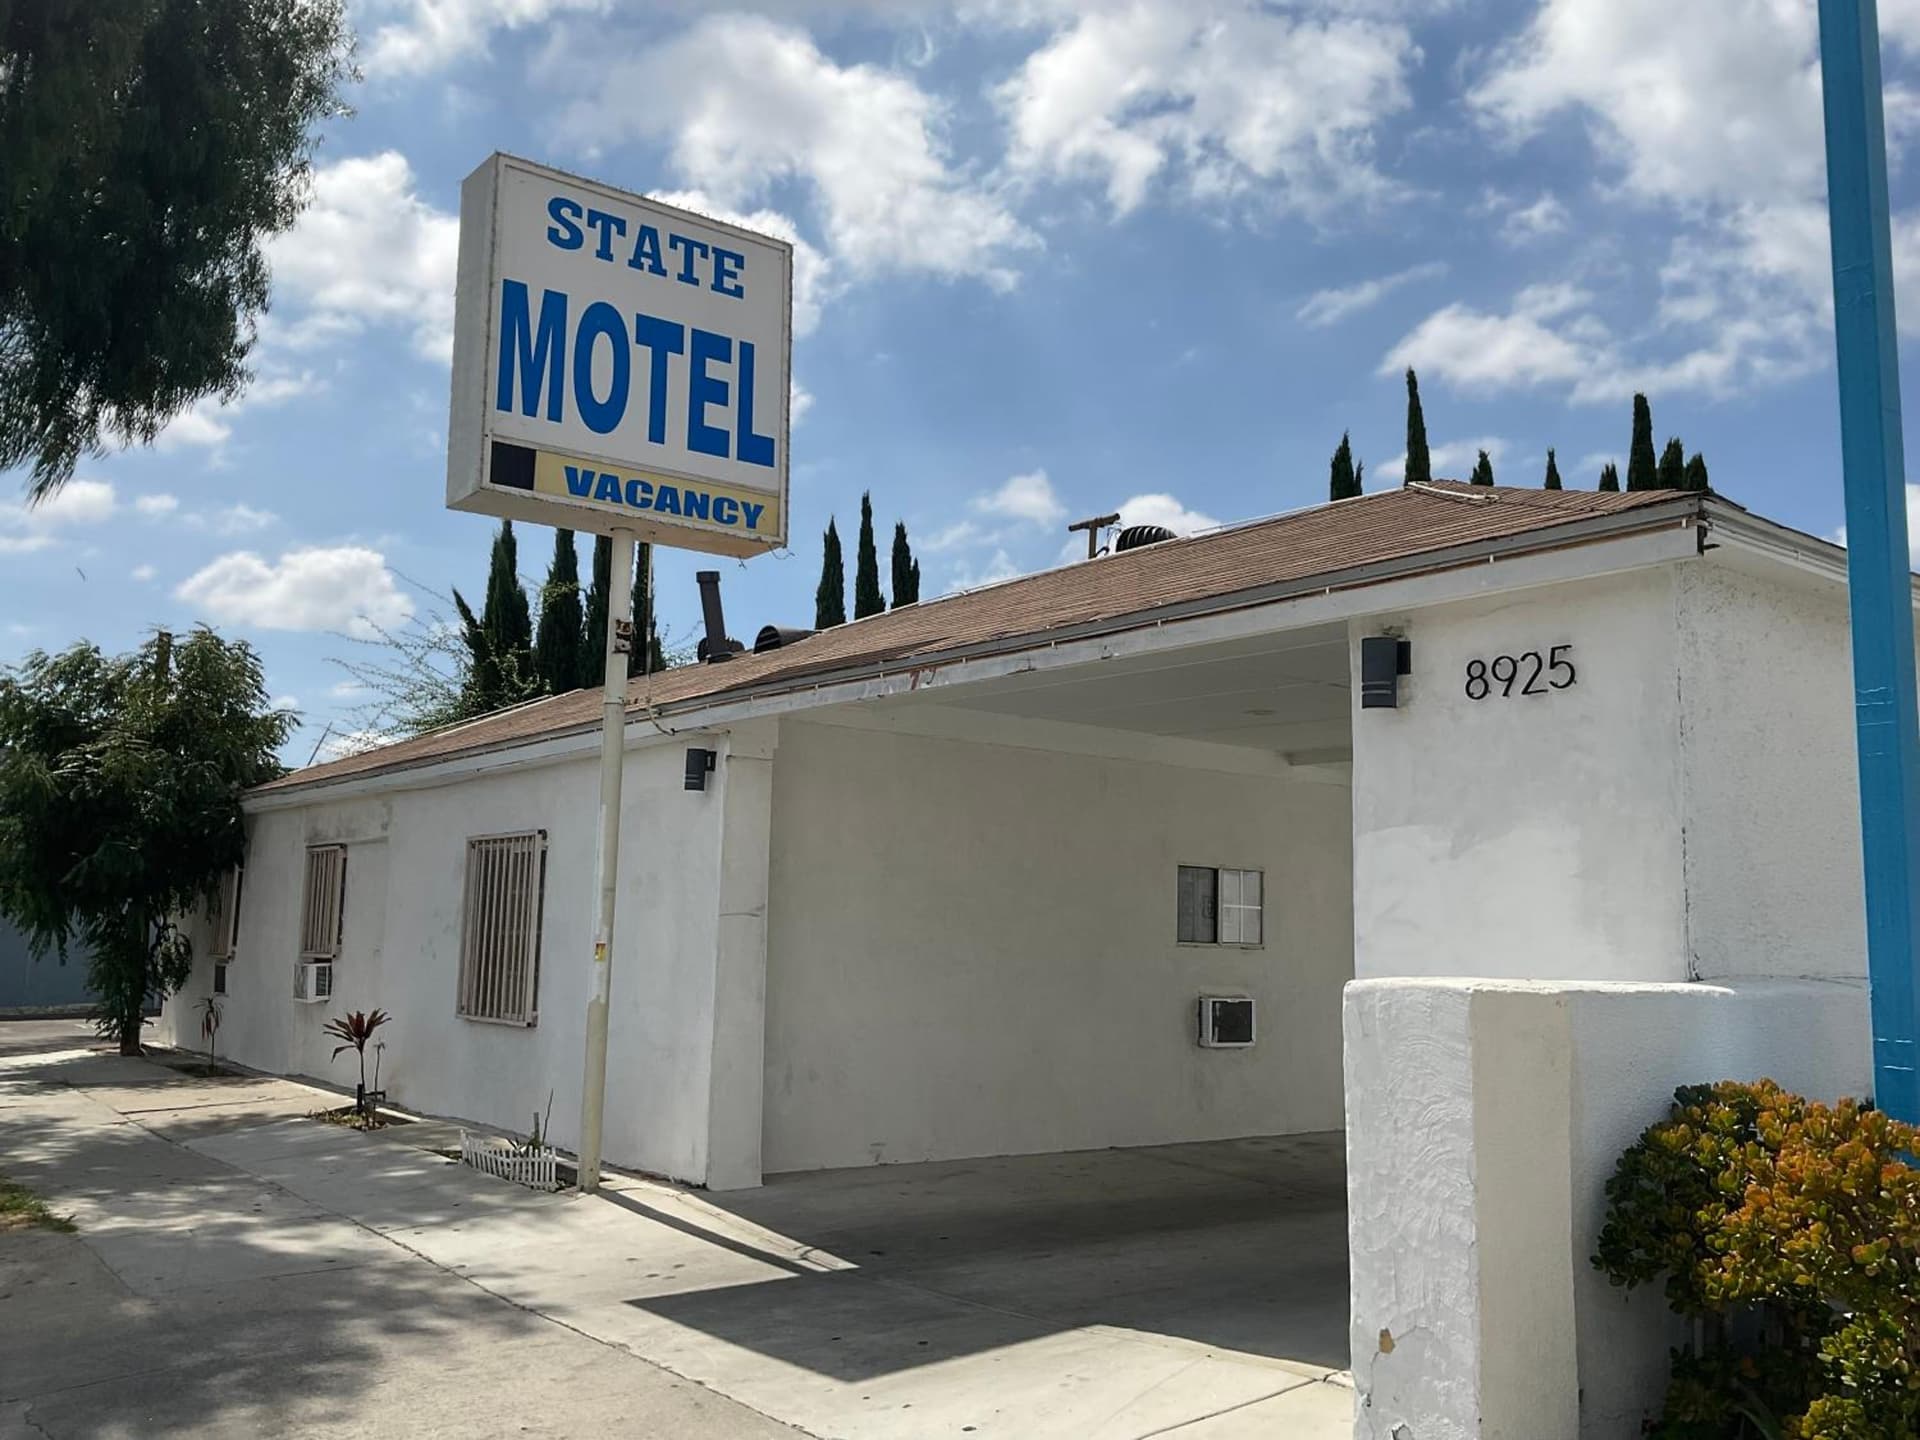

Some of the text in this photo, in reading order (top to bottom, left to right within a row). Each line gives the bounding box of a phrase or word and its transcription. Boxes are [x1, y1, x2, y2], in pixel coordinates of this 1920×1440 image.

[547, 196, 745, 299] STATE
[496, 278, 775, 468] MOTEL
[564, 465, 765, 530] VACANCY
[1465, 644, 1576, 700] 8925
